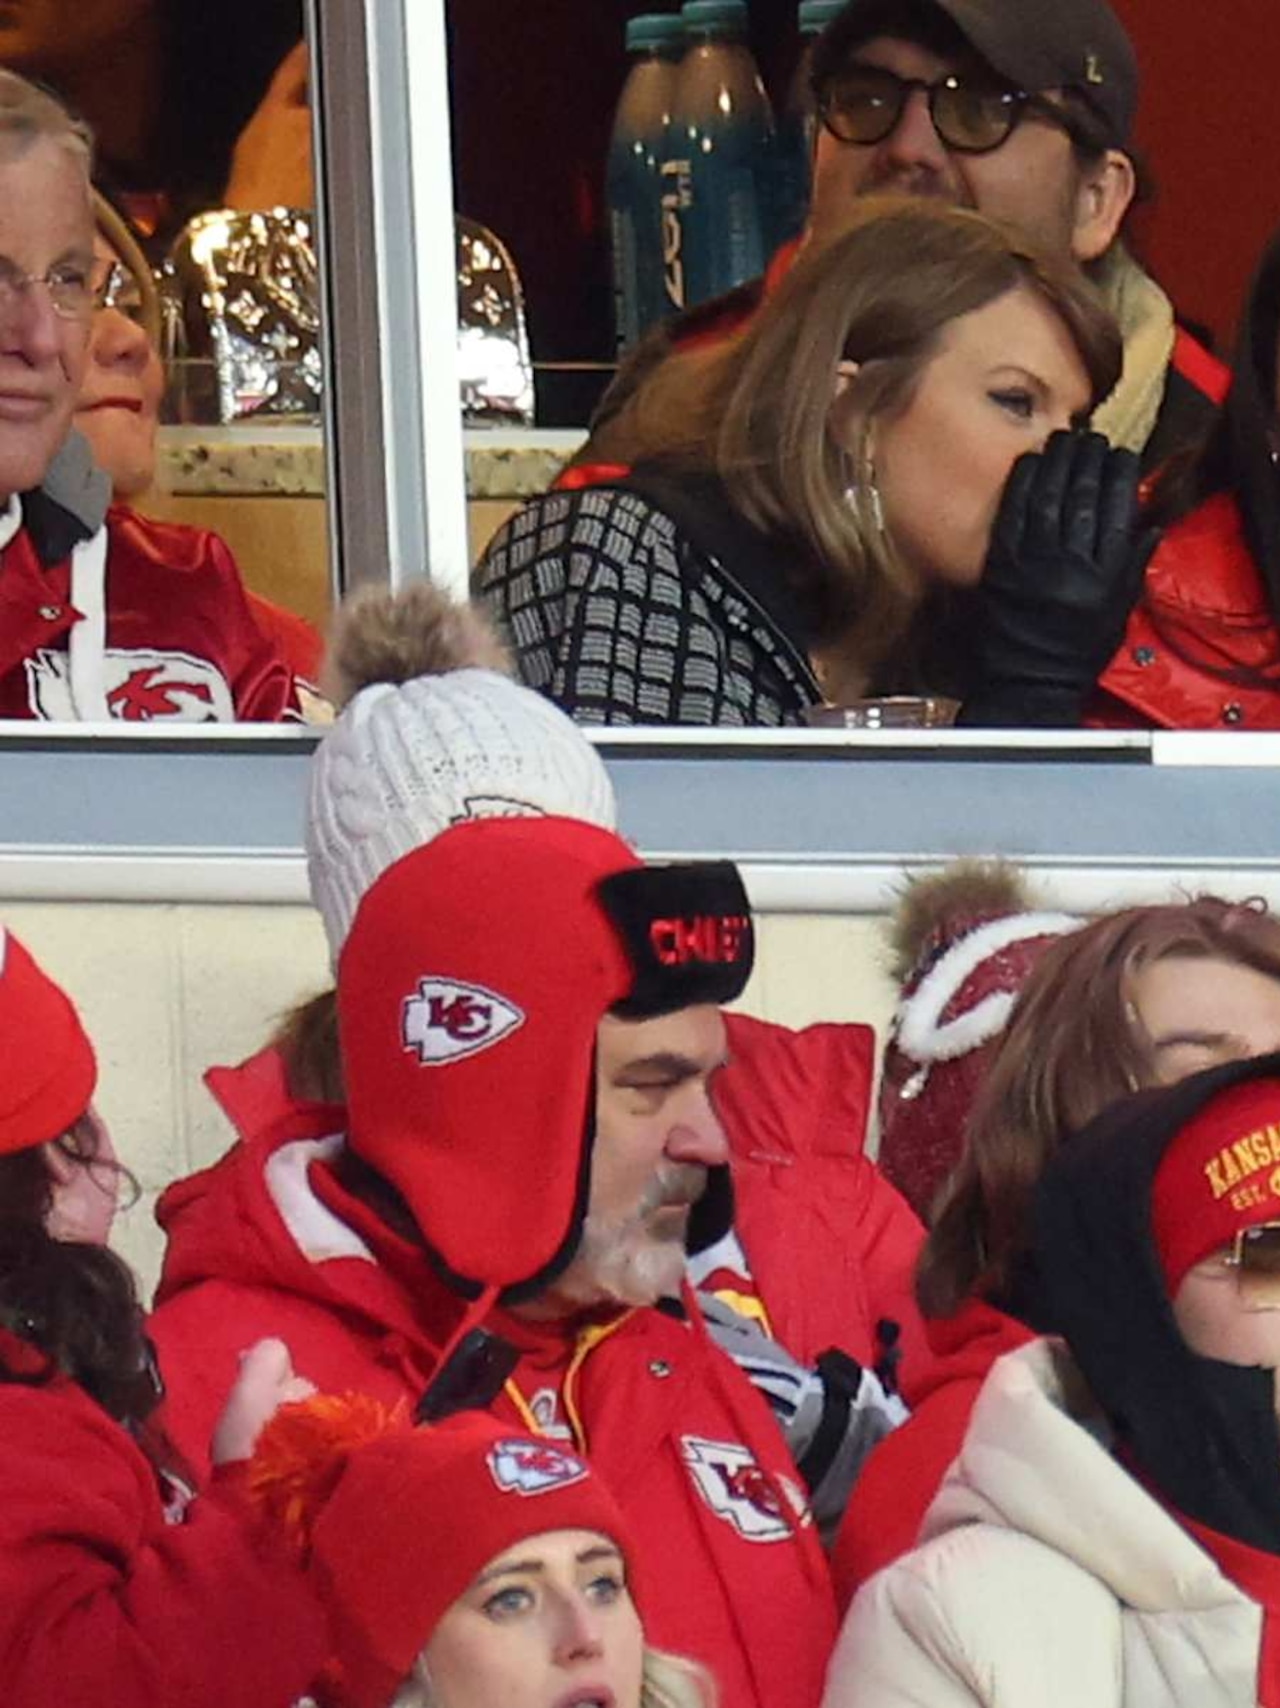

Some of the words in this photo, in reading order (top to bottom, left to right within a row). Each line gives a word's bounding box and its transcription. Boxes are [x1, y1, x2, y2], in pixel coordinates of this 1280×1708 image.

[650, 916, 749, 966] CHIE
[427, 995, 492, 1042] KC
[1230, 1184, 1269, 1212] EST.
